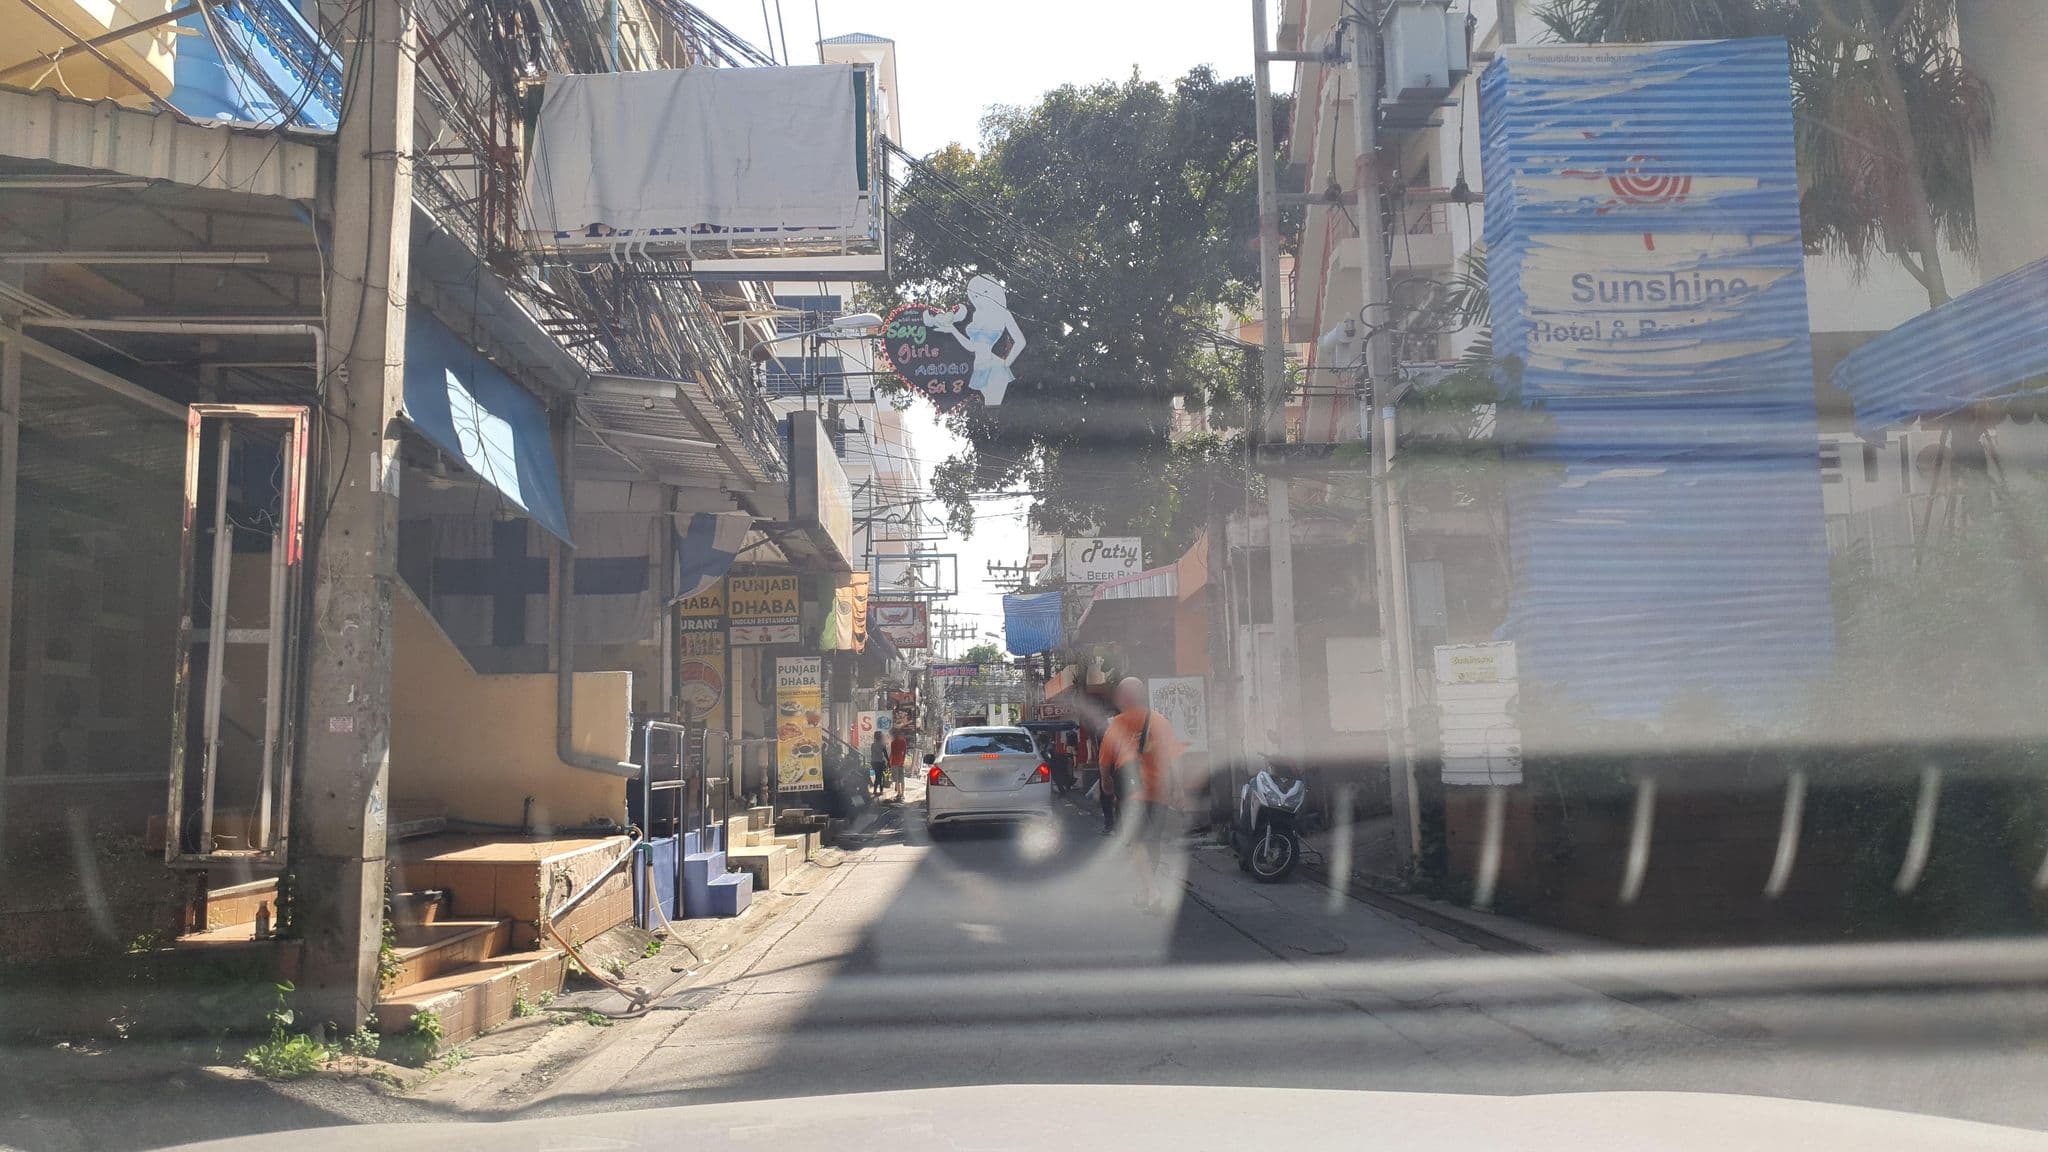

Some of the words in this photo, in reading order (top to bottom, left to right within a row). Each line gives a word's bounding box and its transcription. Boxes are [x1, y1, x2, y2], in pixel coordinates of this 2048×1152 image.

[1571, 271, 1748, 303] Sunshine
[1532, 319, 1601, 342] Hotel
[1081, 539, 1138, 568] Patsy
[732, 578, 796, 595] PUNJABI
[731, 598, 797, 615] DHABA
[778, 665, 820, 676] PUNJABI
[781, 677, 817, 687] DHABA
